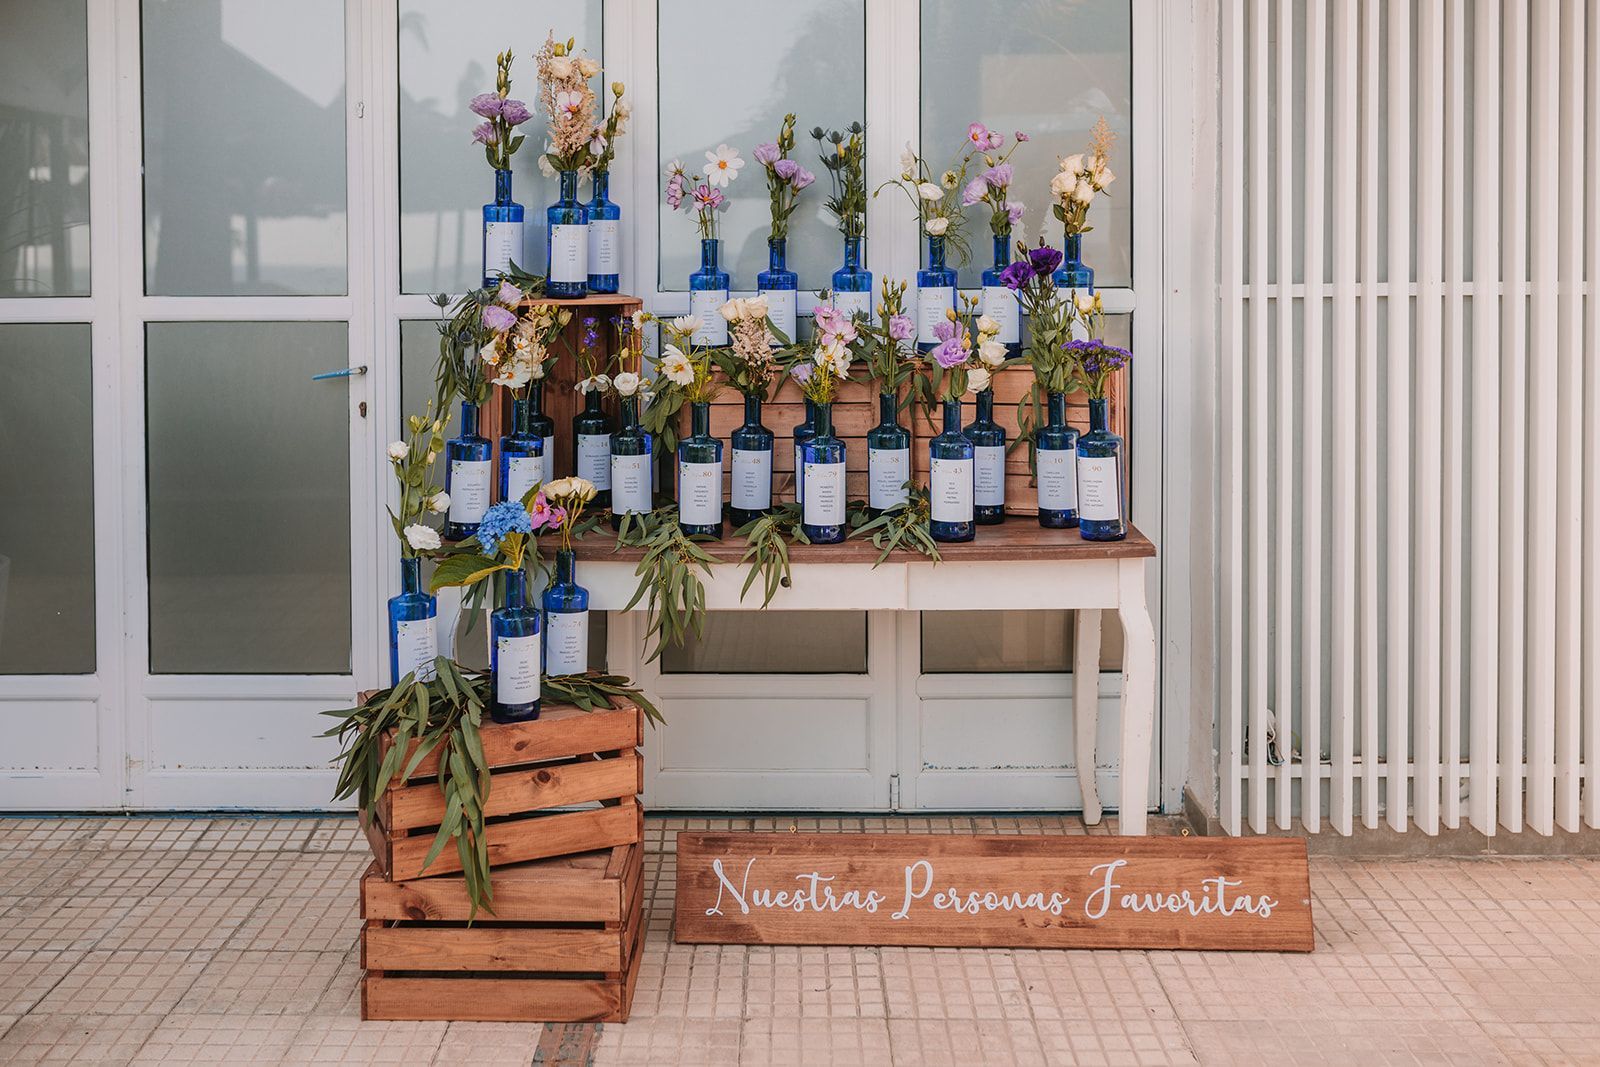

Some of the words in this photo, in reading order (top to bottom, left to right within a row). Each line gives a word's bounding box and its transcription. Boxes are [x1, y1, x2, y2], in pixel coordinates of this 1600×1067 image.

[705, 857, 886, 916] Nuestras
[891, 860, 1070, 920] Personas
[1084, 859, 1278, 919] Favoritas
